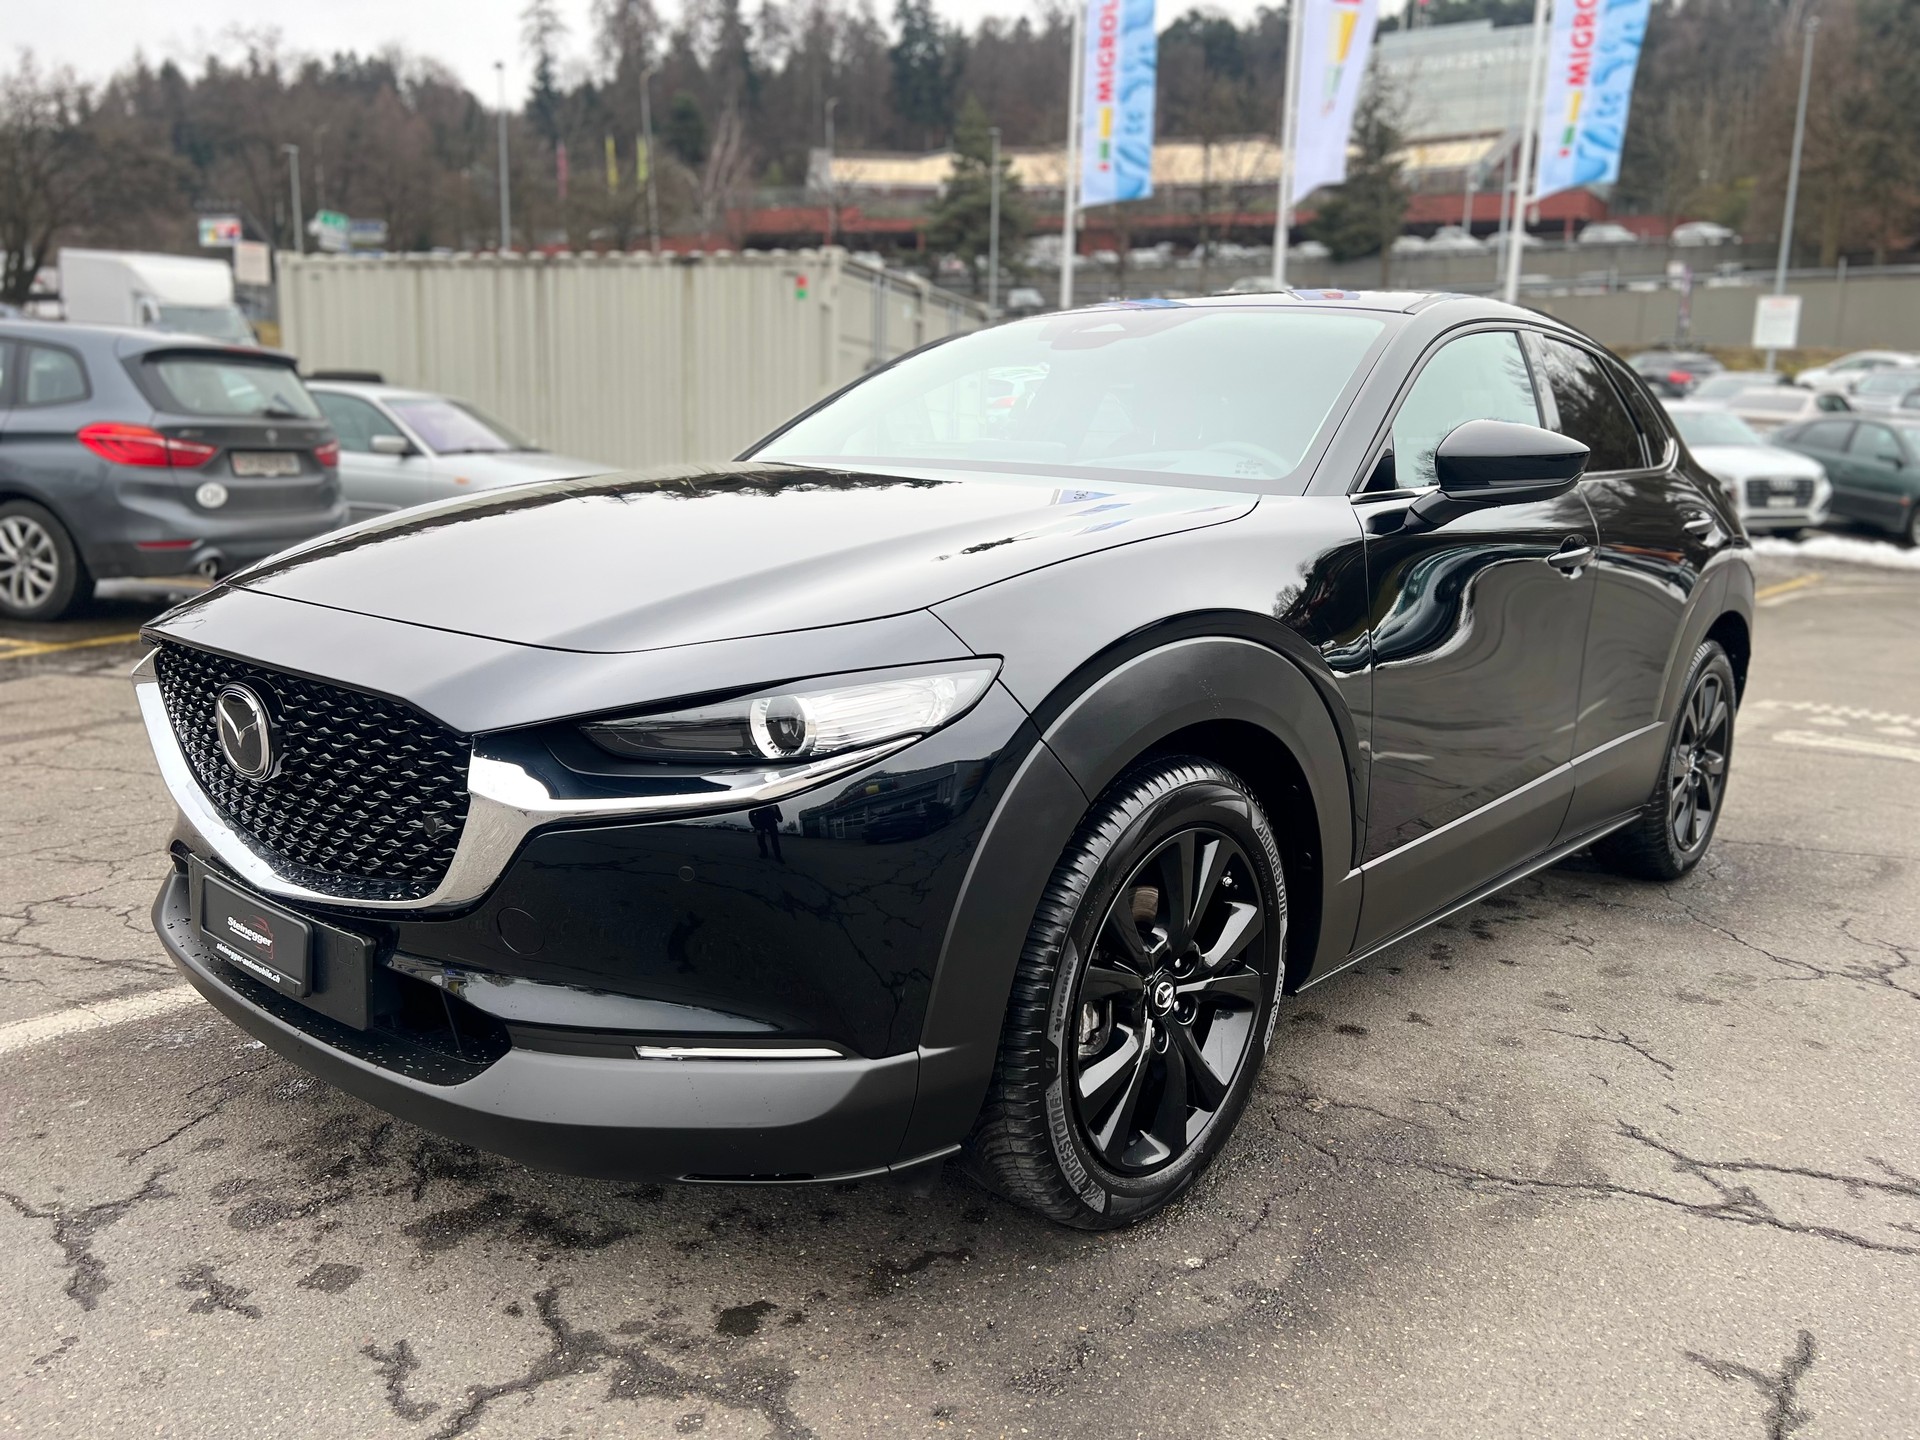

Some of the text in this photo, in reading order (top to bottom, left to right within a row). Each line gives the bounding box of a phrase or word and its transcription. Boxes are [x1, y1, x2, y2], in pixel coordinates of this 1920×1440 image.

[1256, 821, 1287, 922] BRIDGESTONE
[227, 916, 273, 947] Steinegger
[1049, 1096, 1103, 1202] BRIDGESTONE
